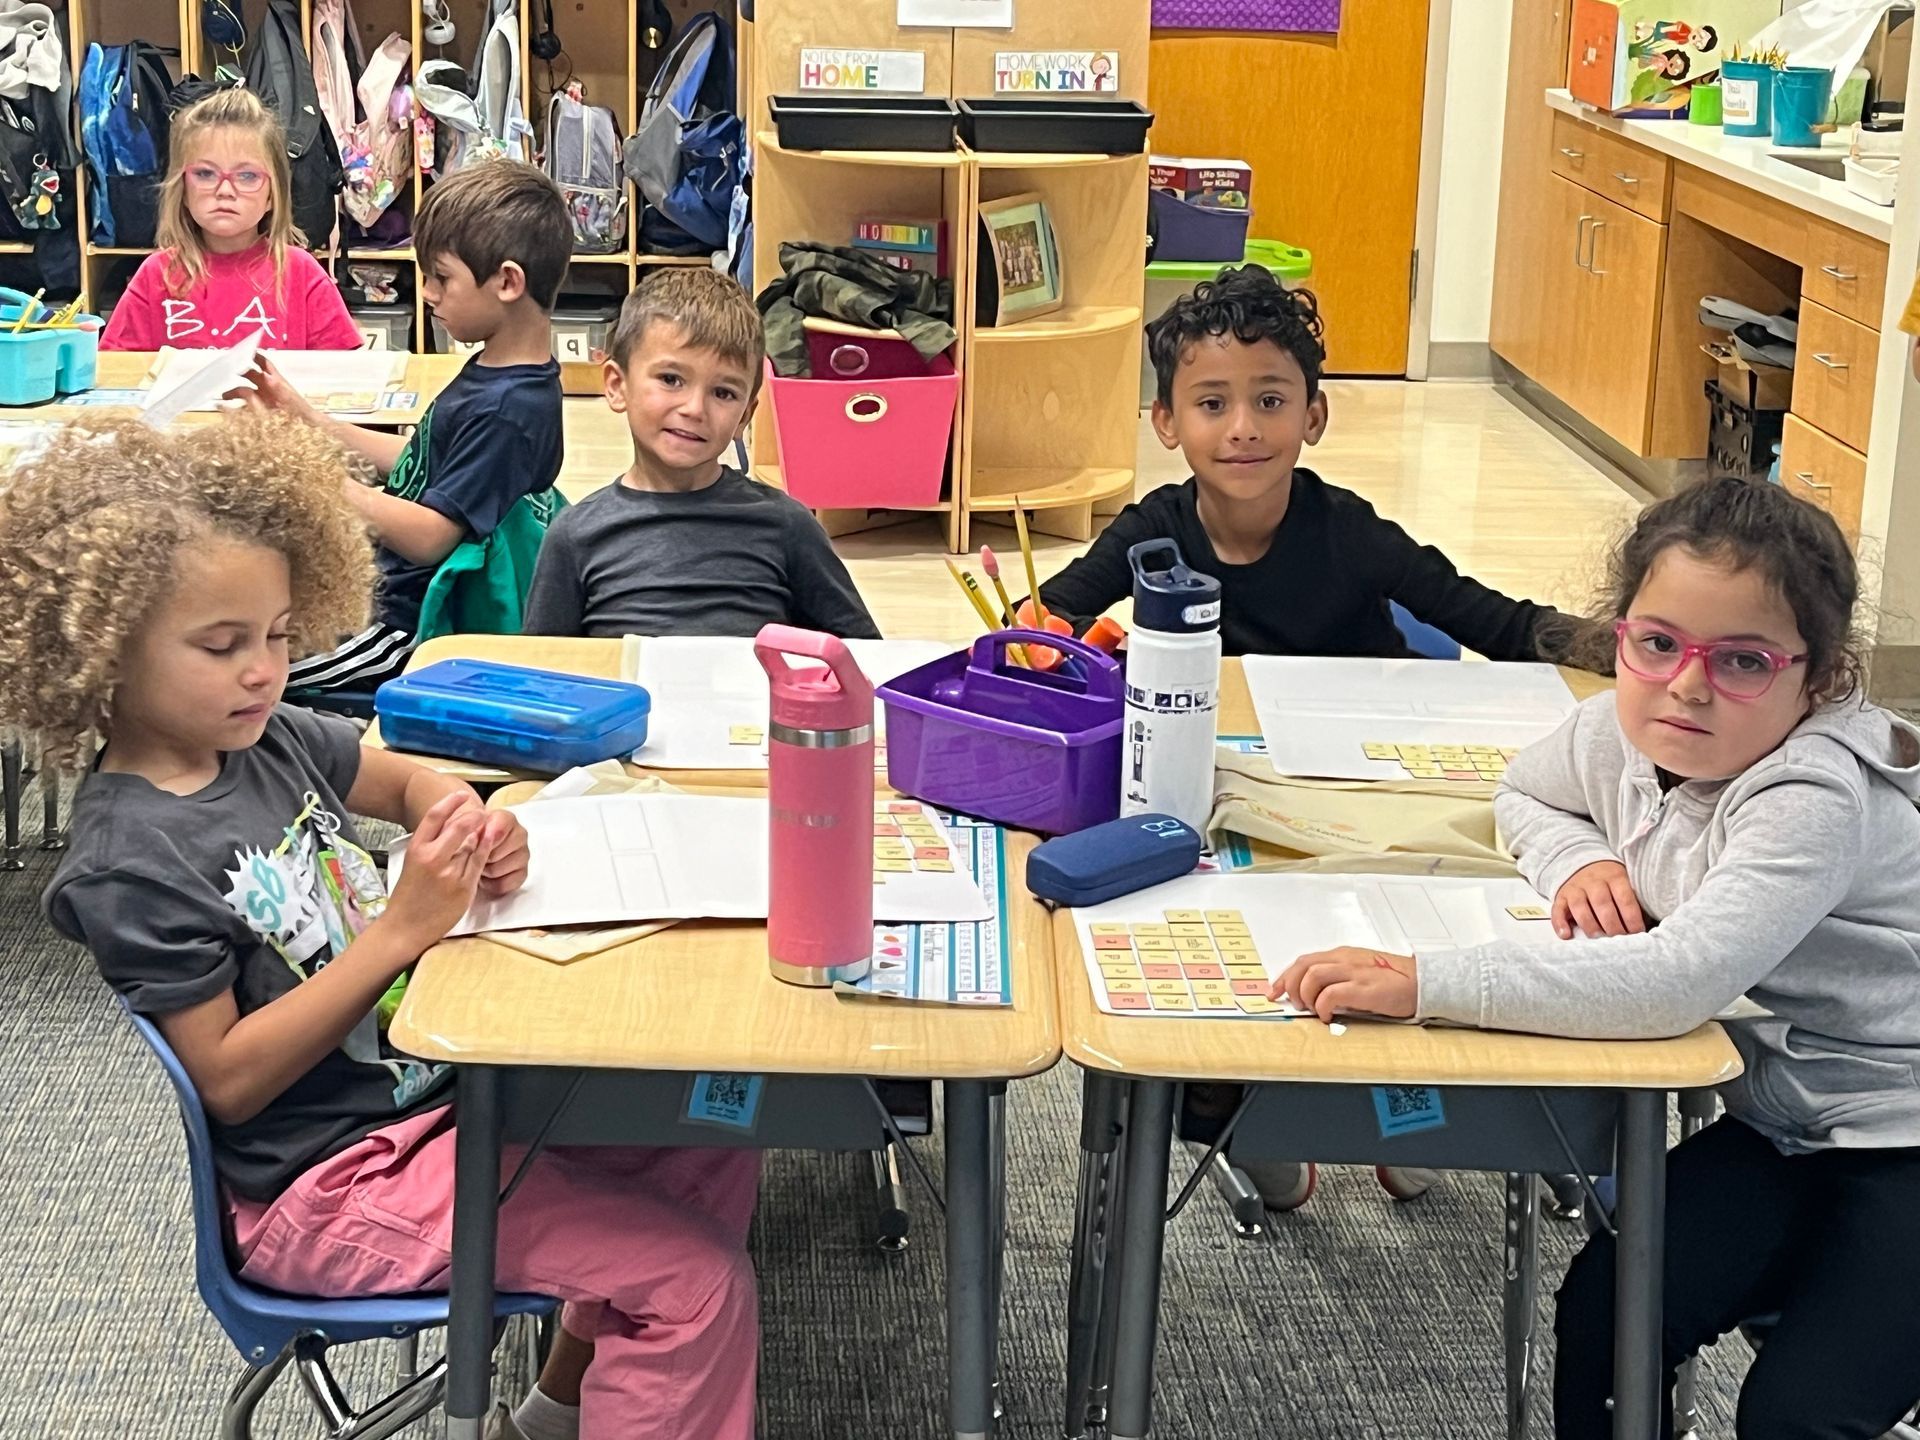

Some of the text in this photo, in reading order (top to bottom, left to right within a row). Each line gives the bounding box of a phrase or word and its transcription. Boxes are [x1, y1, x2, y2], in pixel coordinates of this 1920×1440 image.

[845, 51, 879, 65] FROM
[998, 54, 1087, 71] HOMEWORK
[804, 63, 879, 88] HOME
[997, 70, 1085, 90] TURN IN
[860, 223, 928, 245] HOOY
